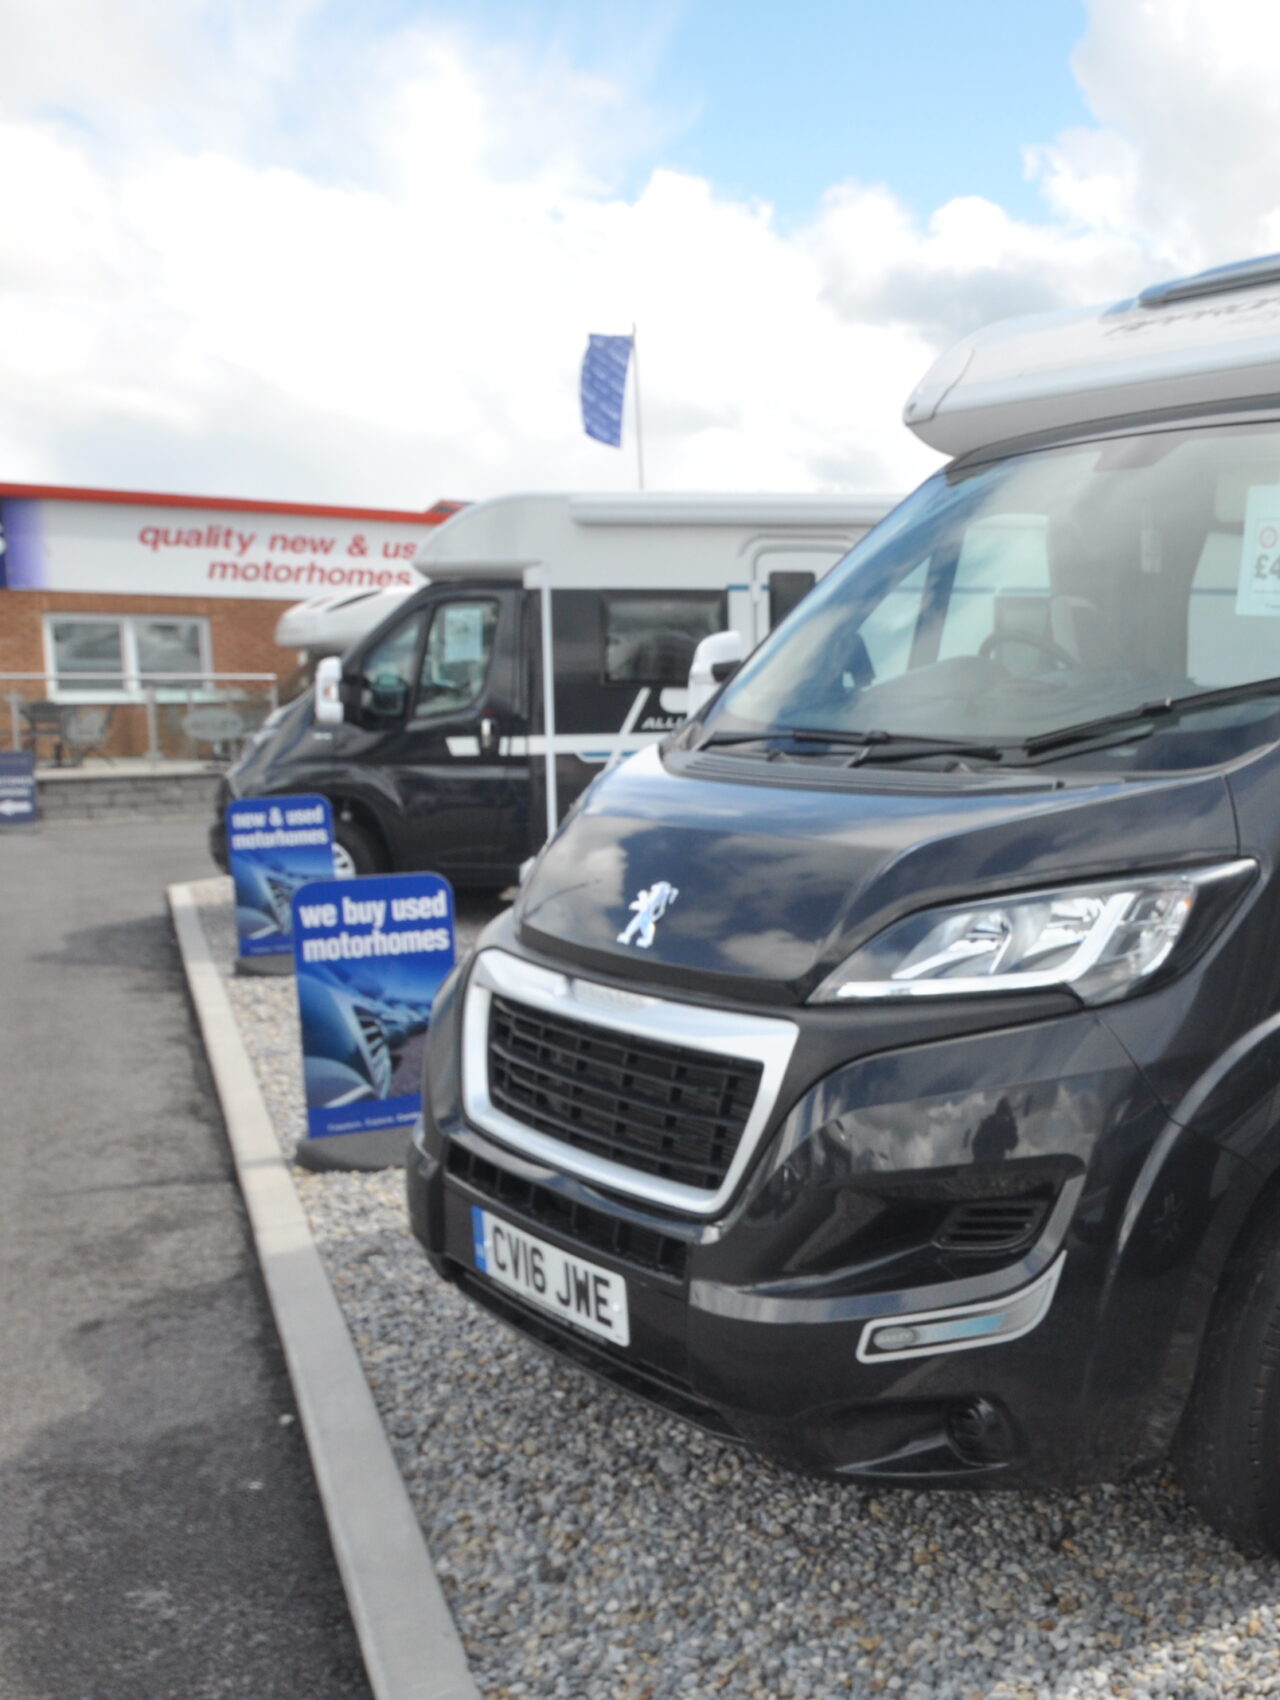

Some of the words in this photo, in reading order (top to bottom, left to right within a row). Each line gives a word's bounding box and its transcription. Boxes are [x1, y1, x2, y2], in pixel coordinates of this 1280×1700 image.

[138, 525, 255, 557] quality
[268, 532, 336, 555] new
[347, 534, 369, 557] &
[383, 540, 418, 559] us
[207, 559, 412, 586] motorhomes
[232, 811, 266, 829] new
[269, 806, 284, 827] &
[285, 804, 325, 826] used
[231, 828, 329, 850] motorhomes
[299, 903, 338, 928] we
[342, 896, 387, 929] buy
[391, 889, 448, 922] used
[302, 927, 450, 962] motorhomes
[492, 1225, 546, 1294] CV16
[556, 1261, 613, 1329] JWE
